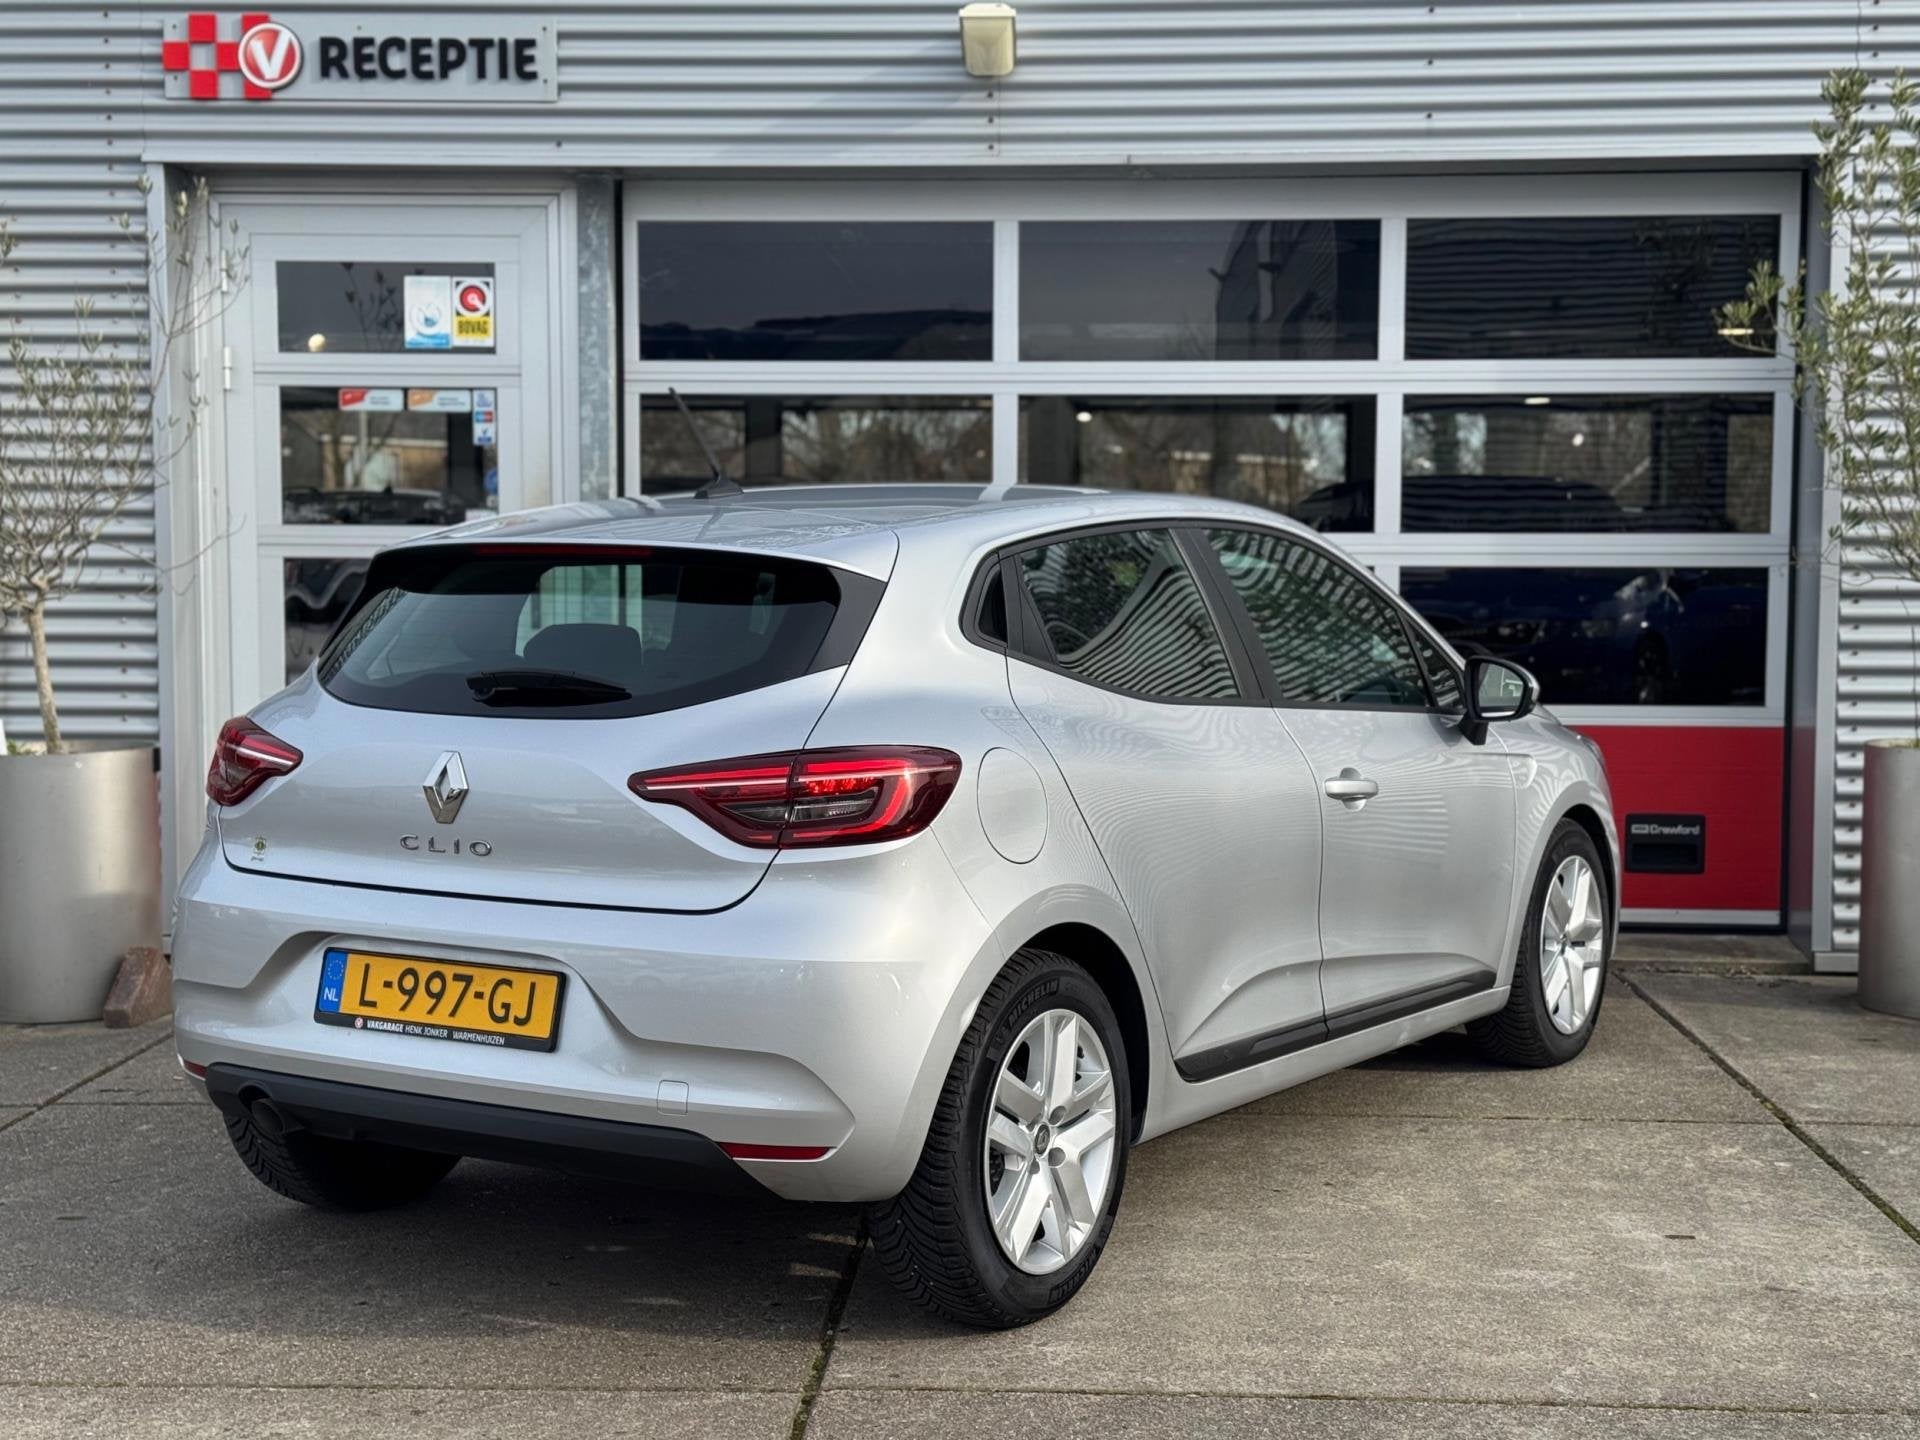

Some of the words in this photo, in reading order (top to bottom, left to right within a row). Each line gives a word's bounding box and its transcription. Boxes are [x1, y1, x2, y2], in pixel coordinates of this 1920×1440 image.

[249, 27, 295, 79] V
[319, 36, 538, 80] RECEPTIE
[458, 319, 489, 335] BOVAG
[1650, 824, 1700, 835] Crawford
[400, 834, 492, 856] CLIO
[324, 987, 338, 1001] NL
[359, 963, 536, 1026] L-997-GJ
[1008, 979, 1058, 1027] MICHELIN
[367, 1019, 403, 1033] VAKGARAGE
[404, 1024, 422, 1034] HENK
[424, 1027, 448, 1038] JONKER
[452, 1030, 505, 1046] WARMENHUIZEN
